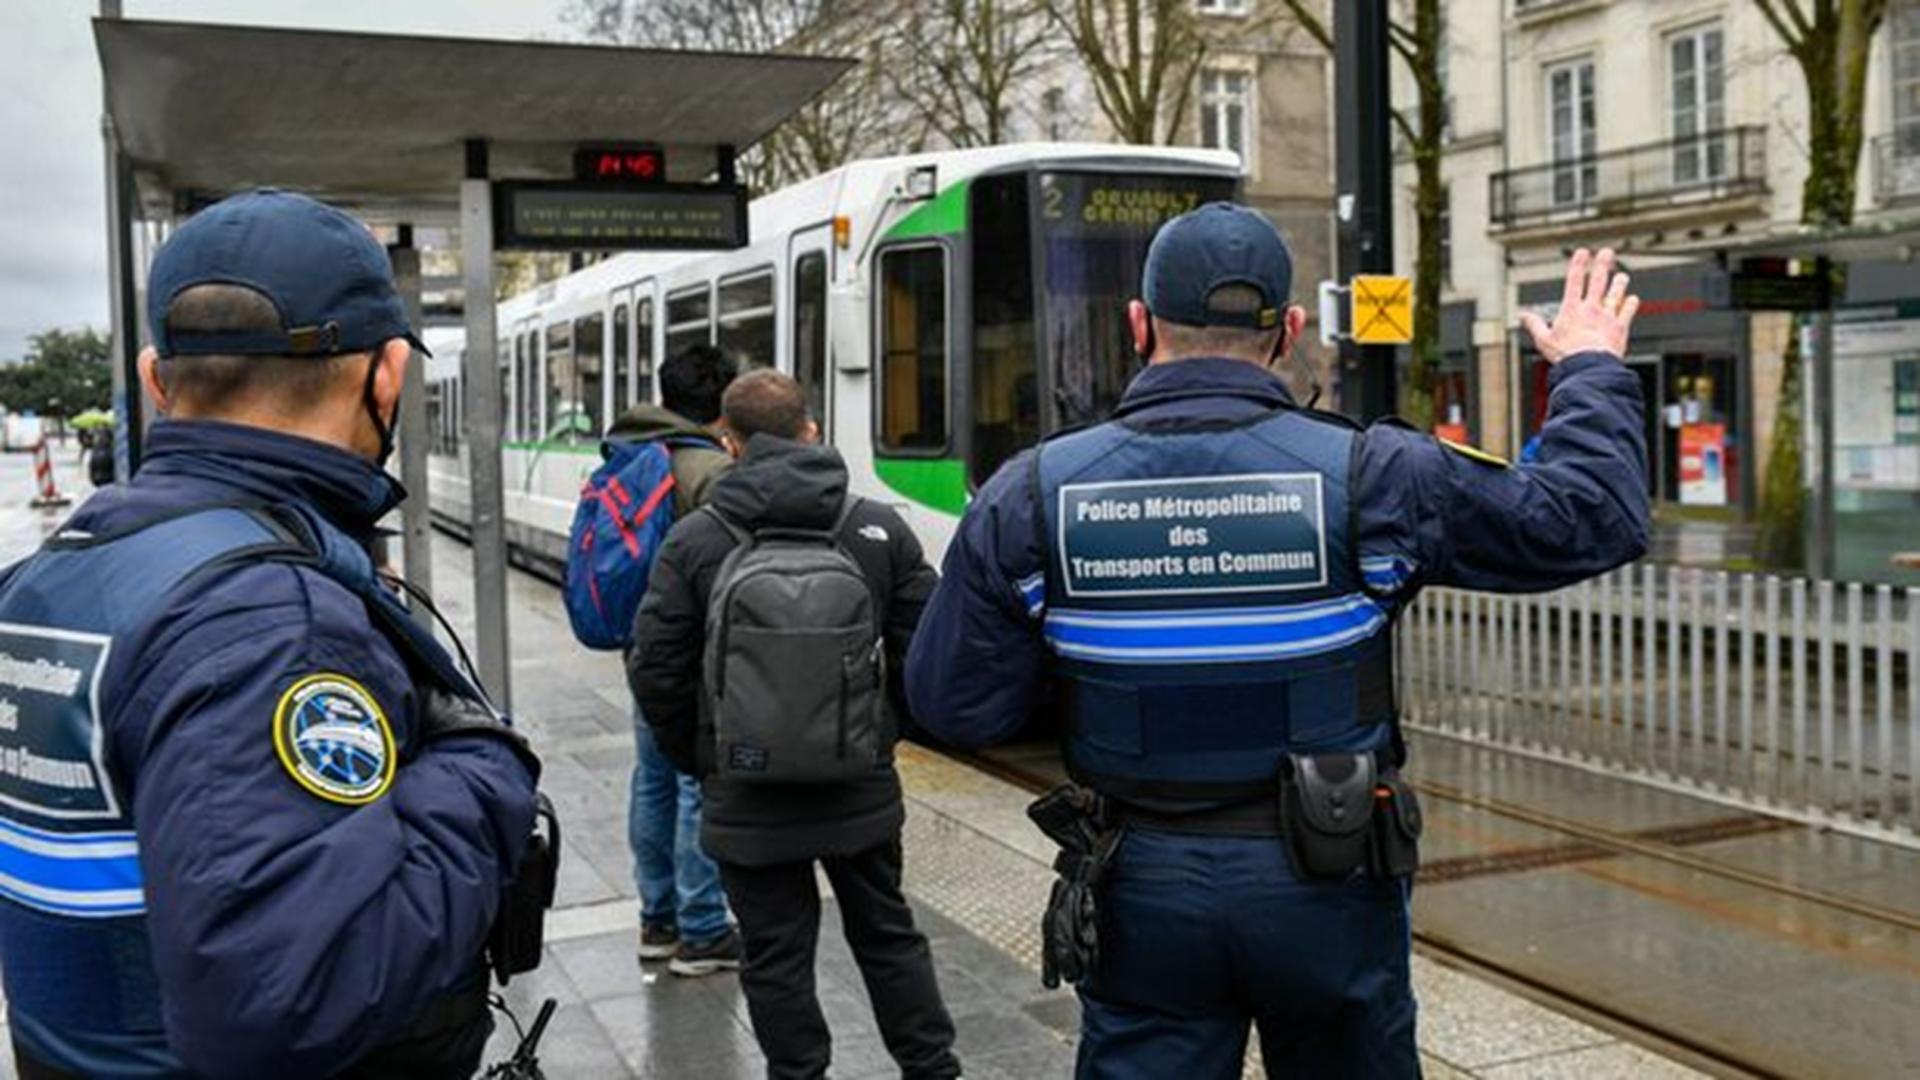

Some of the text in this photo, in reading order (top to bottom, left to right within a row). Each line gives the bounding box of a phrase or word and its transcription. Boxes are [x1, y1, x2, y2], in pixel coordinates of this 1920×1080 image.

[1043, 187, 1063, 218] 2
[1077, 491, 1303, 522] Police Métropolitaine
[1168, 525, 1209, 547] des
[1072, 550, 1315, 579] Transports en Commun
[20, 747, 94, 788] Commun
